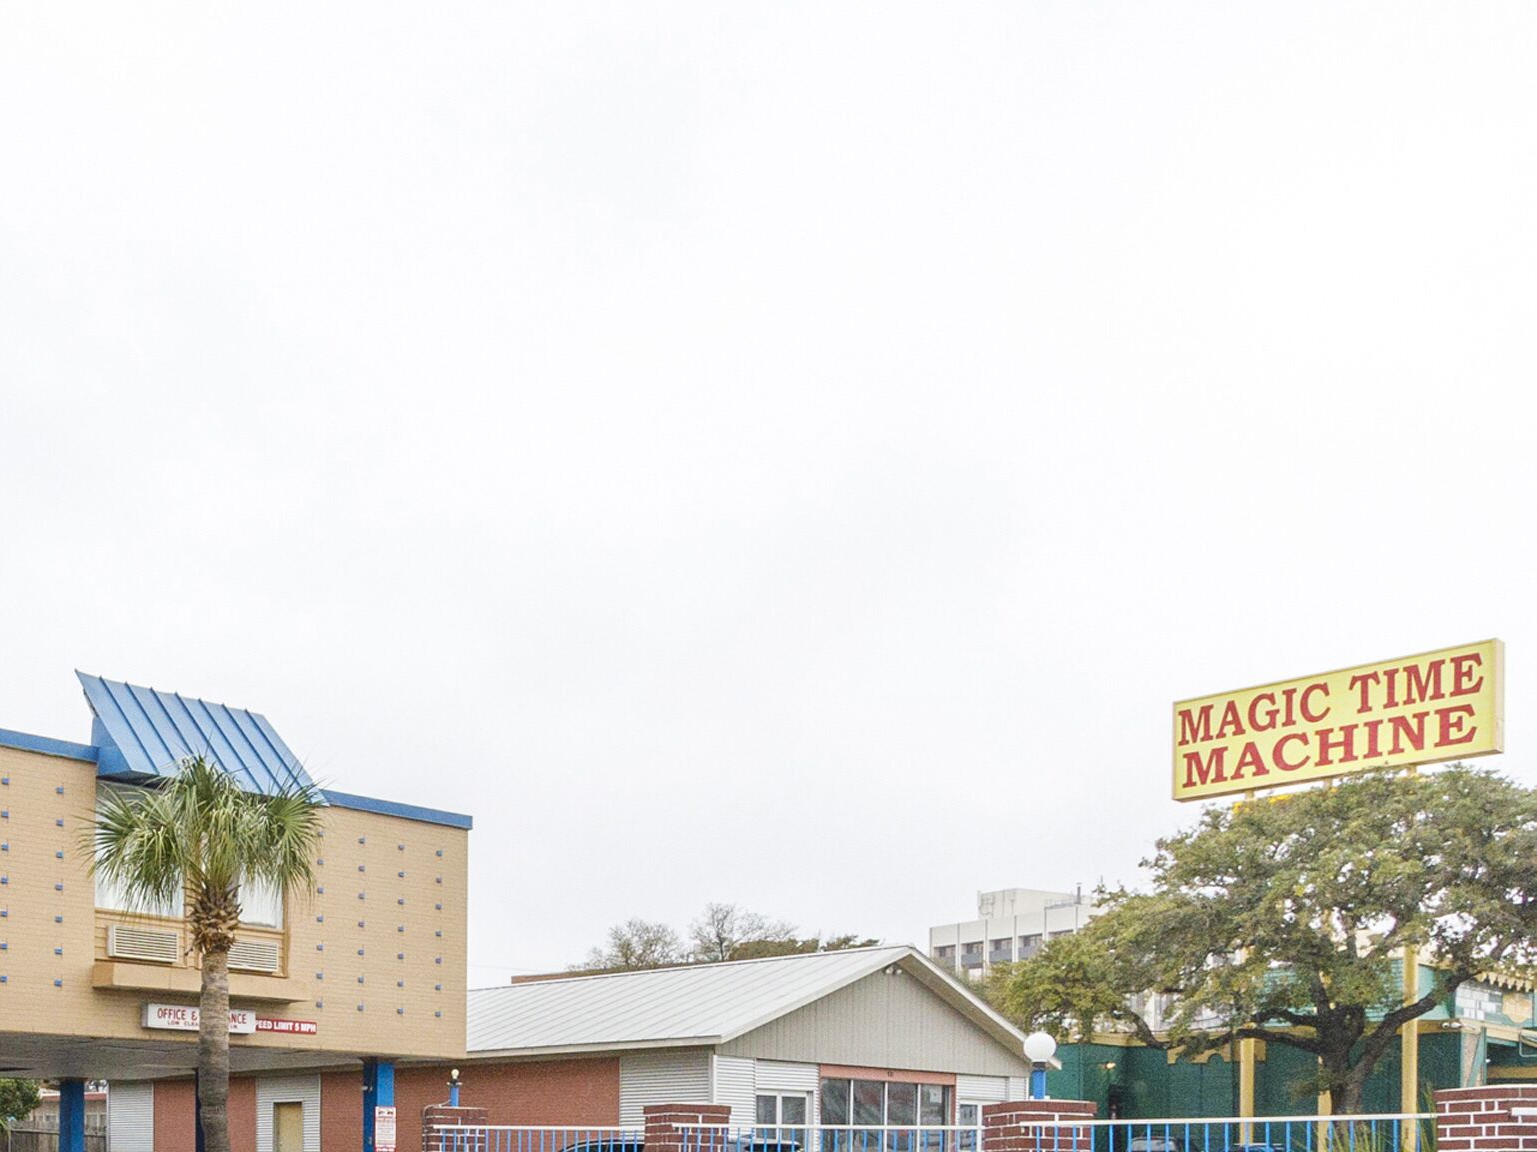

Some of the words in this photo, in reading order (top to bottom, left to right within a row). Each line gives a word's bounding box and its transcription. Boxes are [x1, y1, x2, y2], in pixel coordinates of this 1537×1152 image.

[1177, 681, 1331, 747] MAGIC
[1348, 652, 1485, 714] TIME
[1182, 703, 1478, 789] MACHINE
[157, 1007, 187, 1020] OFFICE
[255, 1020, 273, 1029] PEED
[273, 1021, 293, 1030] LIMIT
[300, 1023, 317, 1032] MPH
